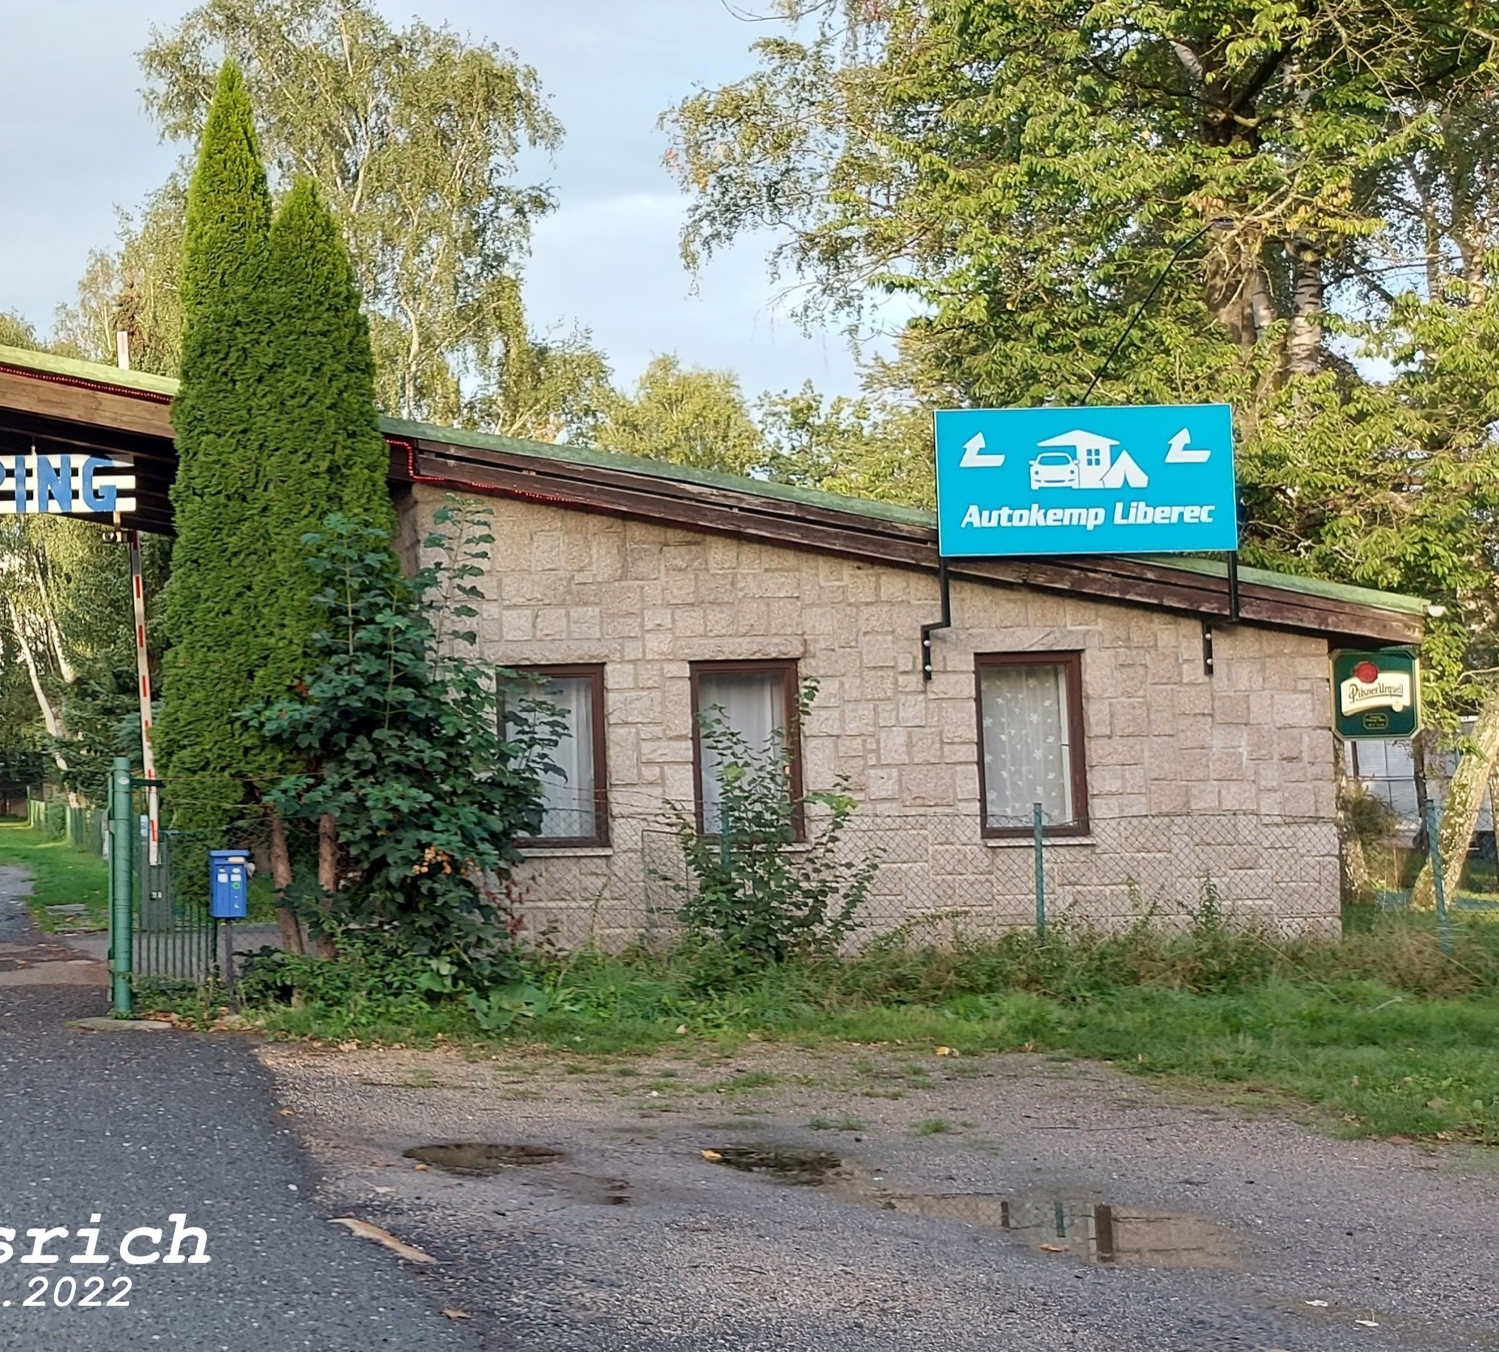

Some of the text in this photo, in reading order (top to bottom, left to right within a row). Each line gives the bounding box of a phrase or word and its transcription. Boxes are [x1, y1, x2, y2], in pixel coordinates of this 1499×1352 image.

[961, 501, 1216, 531] Autokemp Liberec
[1348, 682, 1404, 704] Pilsner Urquell
